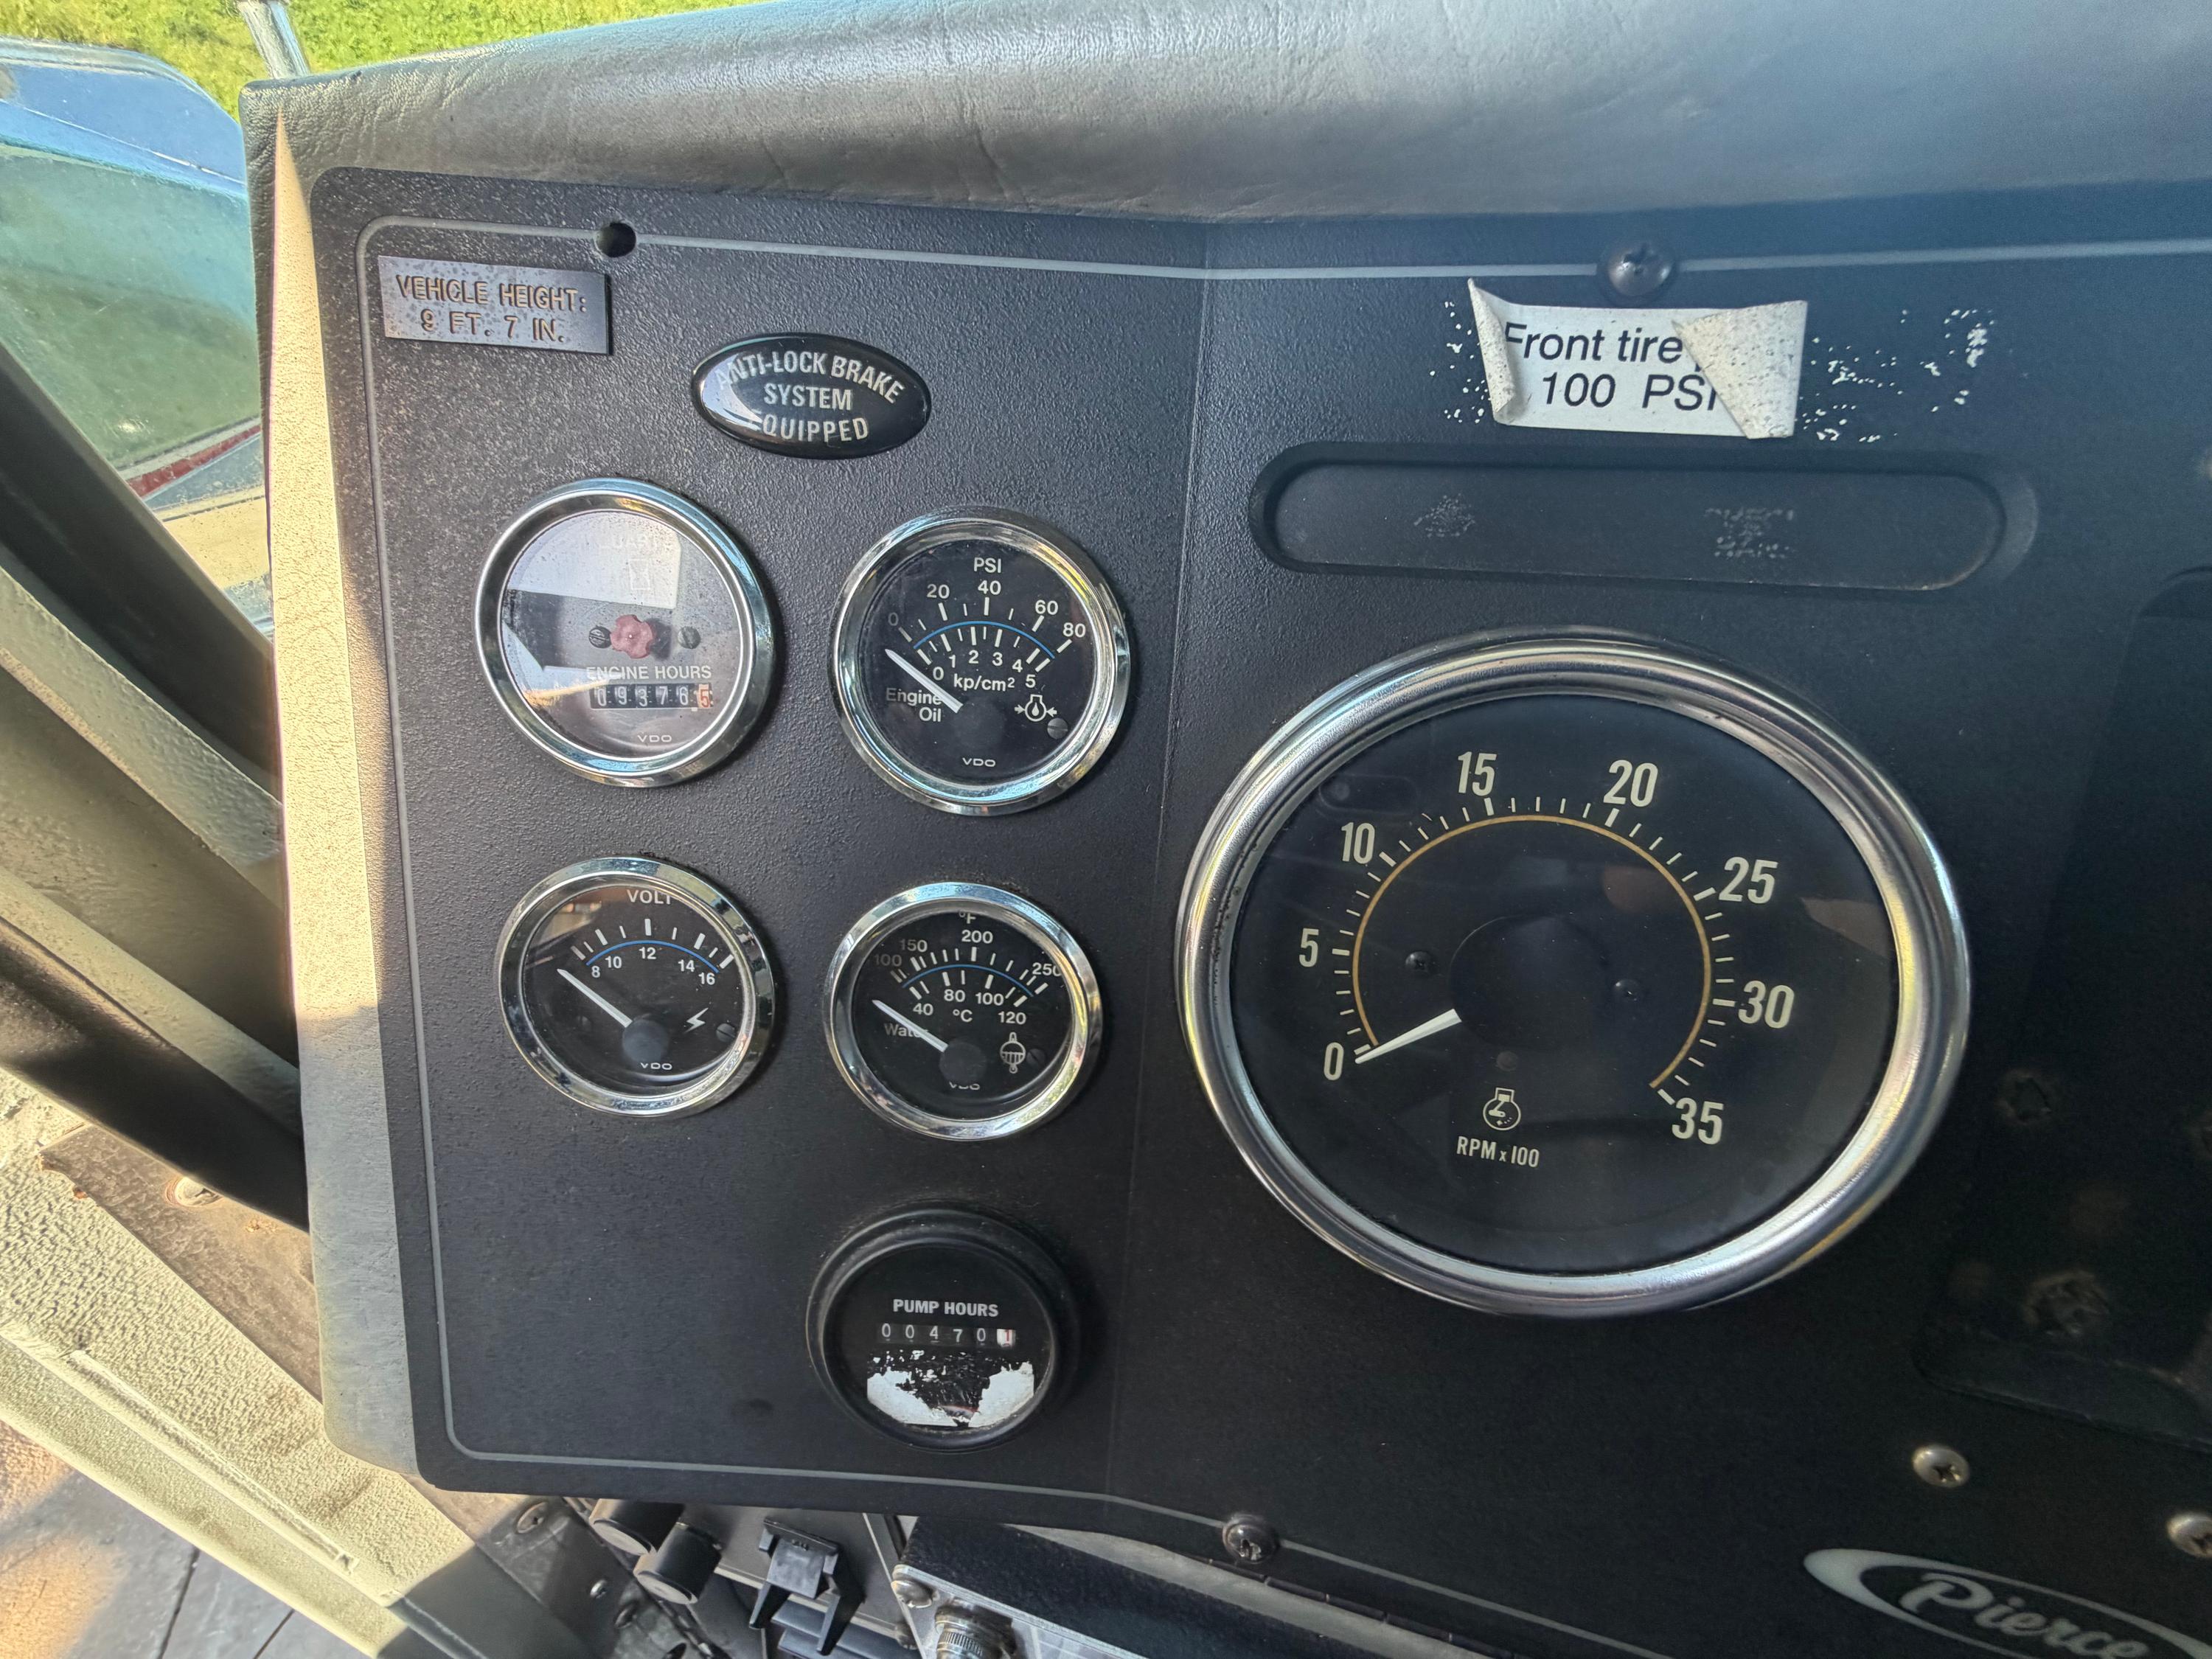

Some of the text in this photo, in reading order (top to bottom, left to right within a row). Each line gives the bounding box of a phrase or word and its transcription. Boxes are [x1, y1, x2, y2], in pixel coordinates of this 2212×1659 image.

[396, 275, 588, 313] VEHICLE HEIGHT:
[420, 308, 566, 343] 9 FT. 7 IN.
[1505, 321, 1683, 364] Front tire
[714, 350, 906, 404] ANTI-LOCK BRAKE
[763, 383, 853, 411] SYSTEM
[1542, 372, 1717, 411] 100 PSI
[973, 557, 1002, 574] PSI
[927, 584, 950, 599] 20
[978, 581, 1001, 595] 40
[1035, 600, 1059, 615] 60
[888, 613, 899, 626] 0
[1062, 624, 1086, 639] 80
[948, 655, 956, 667] 1
[969, 650, 978, 664] 2
[992, 652, 1003, 666] 3
[586, 665, 712, 680] ENGINE HOURS
[1012, 659, 1023, 672] 4
[933, 667, 944, 681] 0
[1026, 675, 1036, 688] 5
[886, 688, 942, 706] Engine
[919, 707, 942, 722] Oil
[637, 734, 672, 742] VDO
[962, 757, 996, 768] VDO
[1457, 751, 1497, 796] 15
[1603, 759, 1659, 807] 20
[1341, 822, 1376, 864] 10
[1718, 856, 1778, 904] 25
[627, 889, 672, 905] VOLT
[961, 930, 993, 944] 200
[639, 947, 656, 959] 12
[900, 939, 928, 953] 150
[1298, 928, 1319, 967] 5
[605, 956, 622, 969] 10
[678, 959, 695, 972] 14
[591, 966, 601, 978] 8
[698, 973, 715, 985] 16
[944, 990, 966, 1002] 80
[975, 992, 1004, 1006] 100
[913, 1003, 933, 1016] 40
[1737, 980, 1795, 1029] 30
[998, 1012, 1026, 1025] 120
[641, 1062, 672, 1071] VDO
[1324, 1041, 1343, 1081] 0
[1672, 1096, 1725, 1145] 35
[1457, 1135, 1497, 1161] RPM
[1511, 1145, 1540, 1167] 100
[893, 1298, 998, 1317] PUMP HOURS
